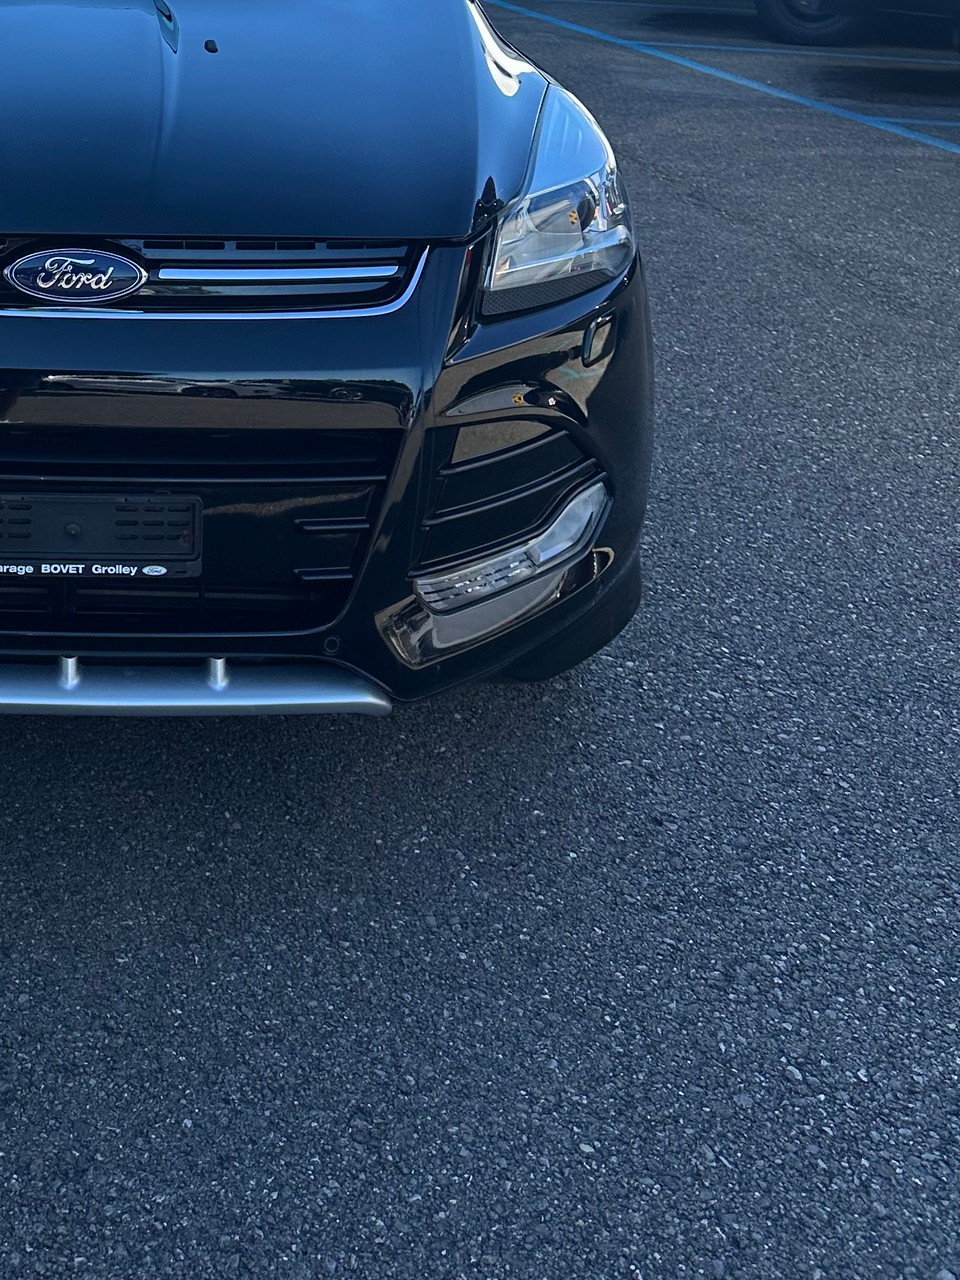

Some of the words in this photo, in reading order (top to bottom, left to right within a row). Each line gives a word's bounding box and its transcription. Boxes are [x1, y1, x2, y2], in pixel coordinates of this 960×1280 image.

[36, 256, 115, 290] Ford
[40, 563, 85, 575] BOVET
[91, 564, 138, 576] Grolley
